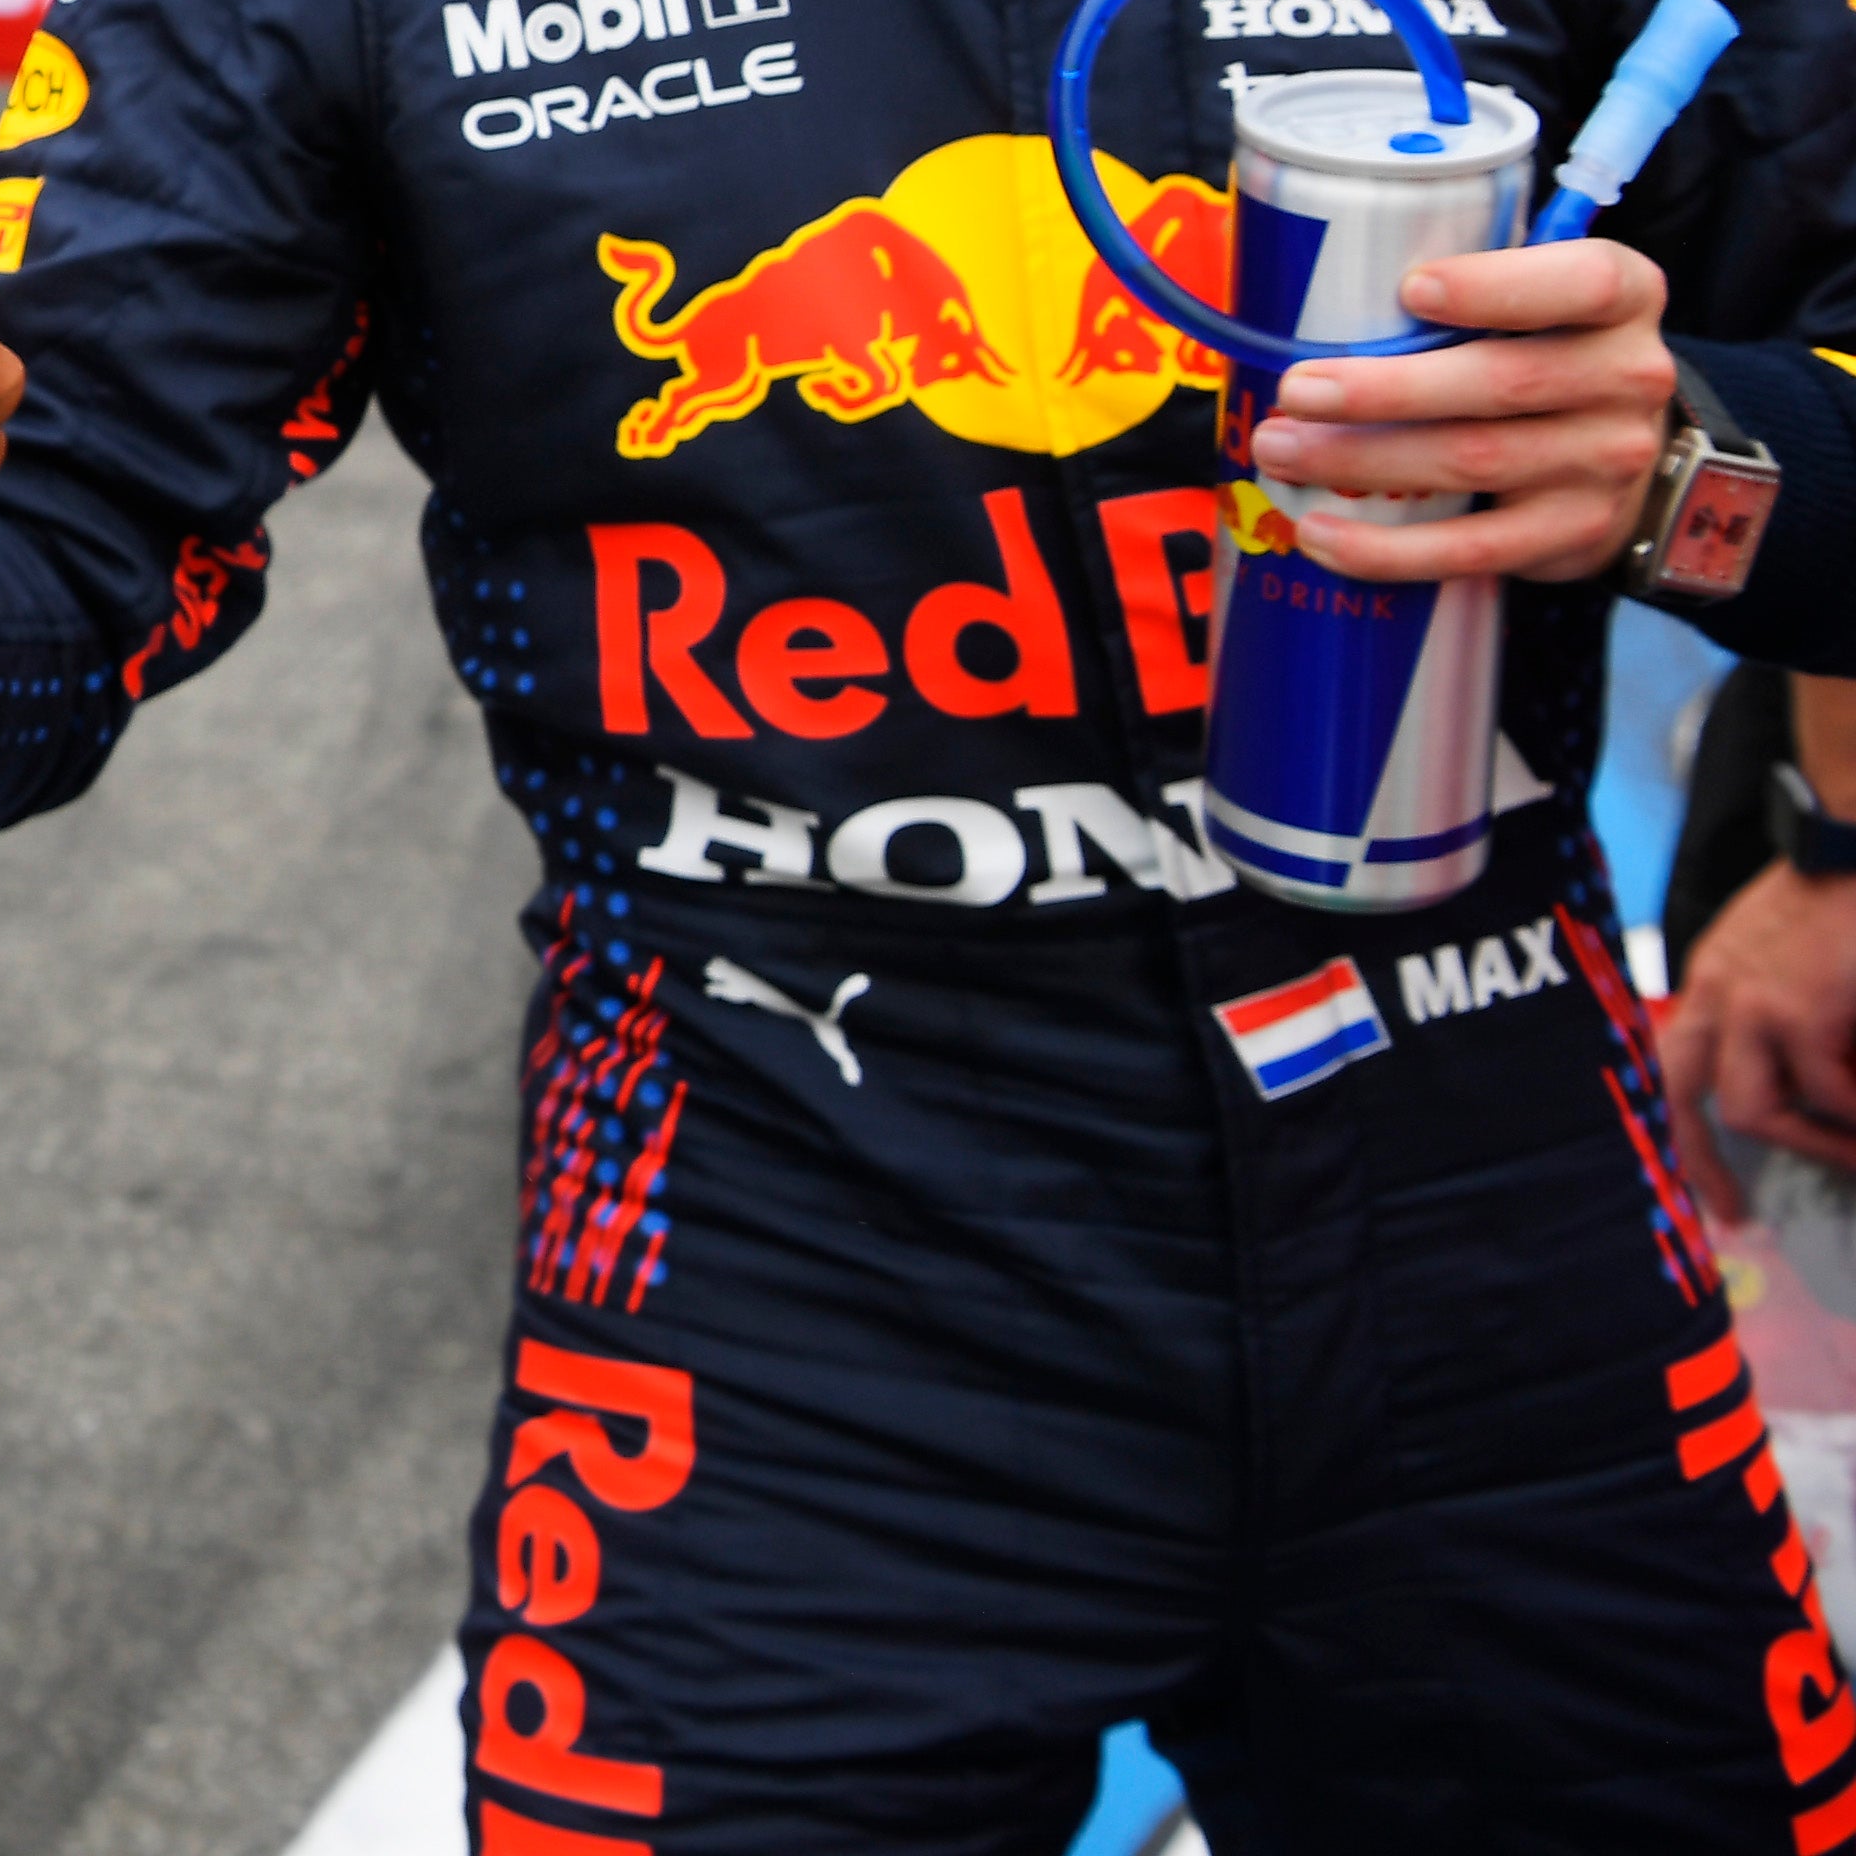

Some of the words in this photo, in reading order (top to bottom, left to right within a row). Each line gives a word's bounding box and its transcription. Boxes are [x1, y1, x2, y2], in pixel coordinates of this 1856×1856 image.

[459, 40, 805, 152] ORACLE
[589, 487, 1079, 741] Red
[1261, 571, 1394, 620] DRINK
[1398, 919, 1568, 1024] MAX
[474, 1337, 696, 1818] Red
